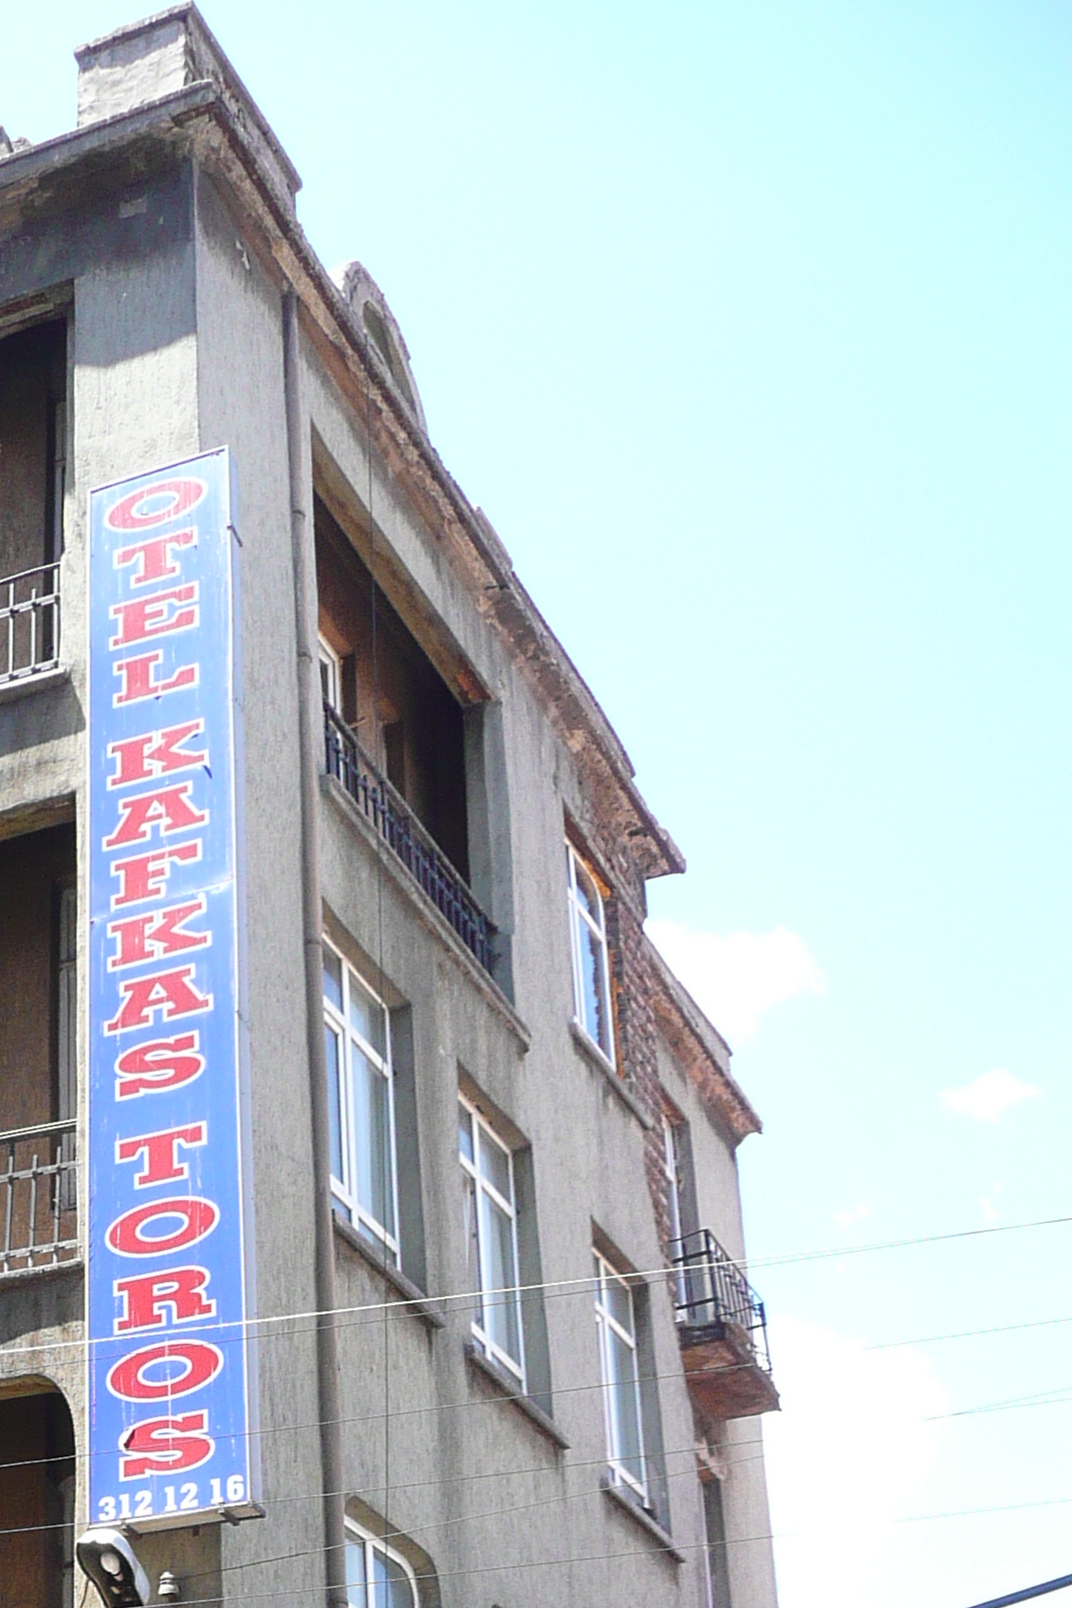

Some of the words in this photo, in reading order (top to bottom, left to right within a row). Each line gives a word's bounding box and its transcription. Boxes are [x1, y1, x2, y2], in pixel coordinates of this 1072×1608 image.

[105, 474, 209, 708] OTEL
[101, 717, 214, 1101] KAFKAS
[105, 1120, 224, 1482] TOROS
[97, 1488, 153, 1522] 312
[162, 1482, 199, 1518] 12
[210, 1474, 245, 1508] 16
